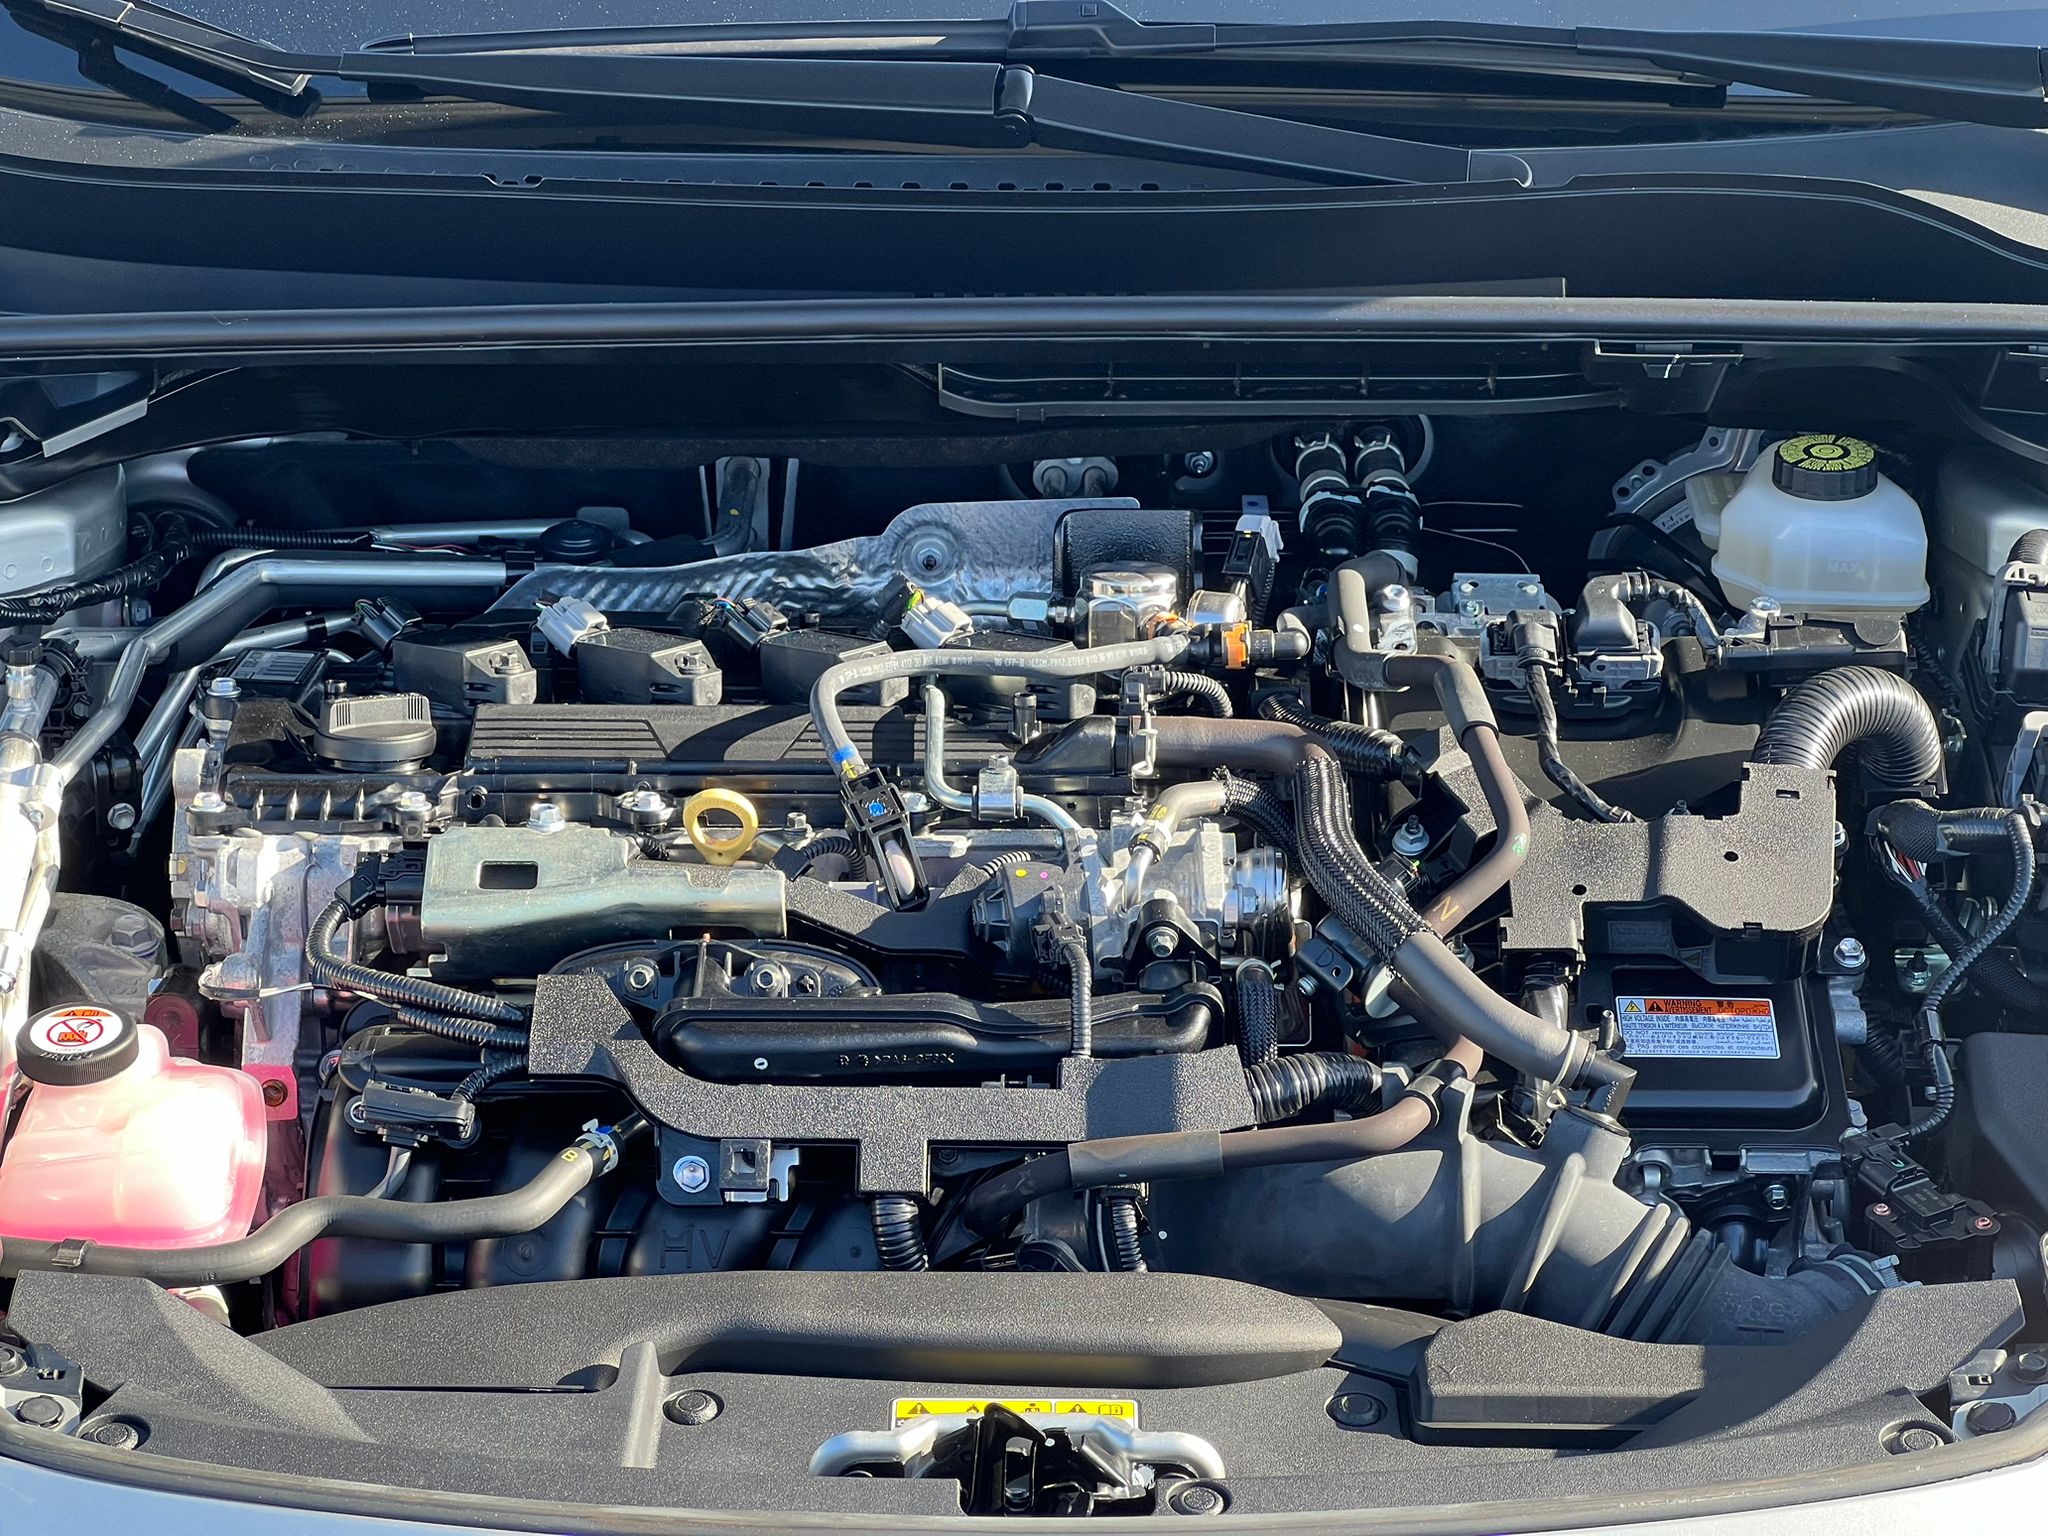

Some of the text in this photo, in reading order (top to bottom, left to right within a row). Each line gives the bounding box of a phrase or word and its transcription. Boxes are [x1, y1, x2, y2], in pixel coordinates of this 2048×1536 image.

[1664, 999, 1701, 1007] WARNING
[1664, 1006, 1712, 1014] AVERTISSEMENT
[660, 1228, 731, 1269] HV
